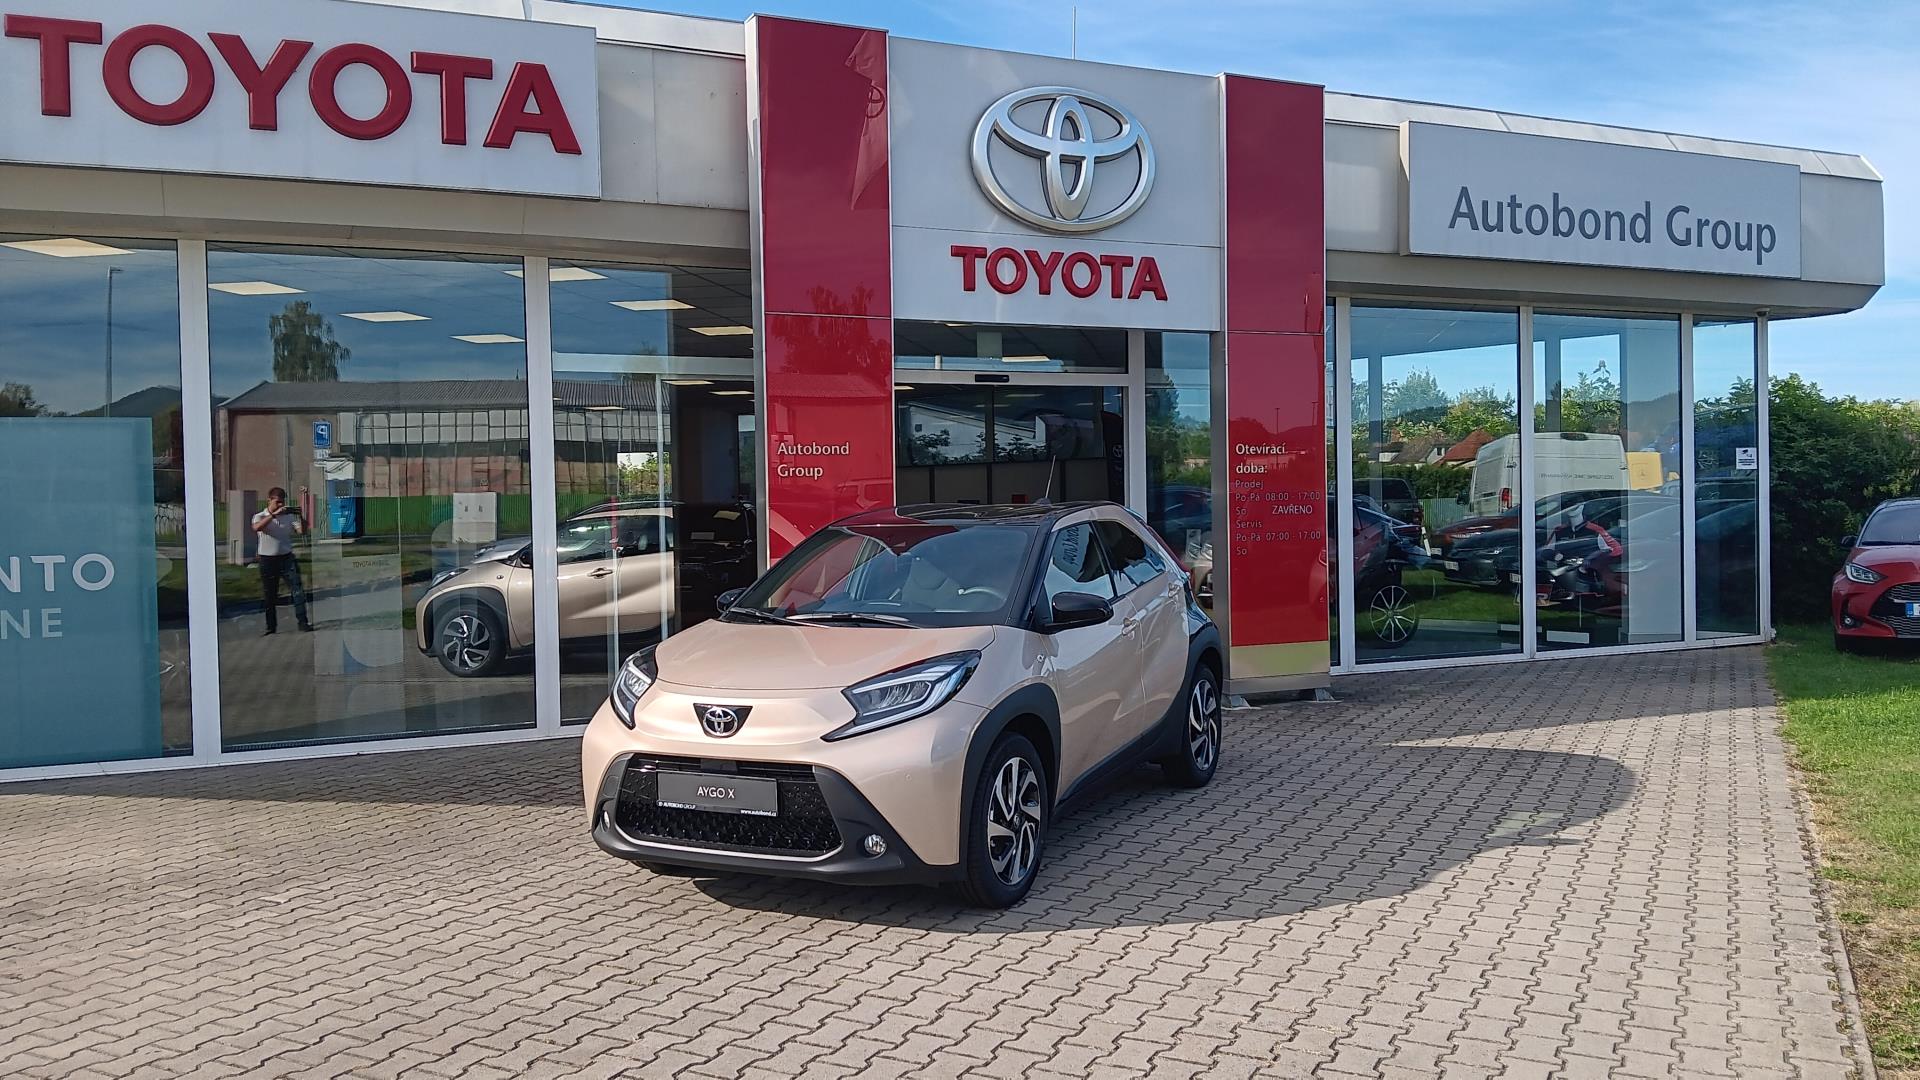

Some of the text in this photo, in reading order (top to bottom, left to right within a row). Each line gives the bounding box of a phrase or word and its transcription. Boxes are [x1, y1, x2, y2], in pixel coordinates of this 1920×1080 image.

[4, 14, 582, 155] TOYOTA
[1448, 186, 1777, 266] Autobond Group
[951, 245, 1168, 301] TOYOTA
[777, 441, 850, 455] Autobond
[1235, 442, 1286, 455] Otevírací
[777, 464, 823, 480] Group
[1235, 462, 1268, 474] doba:
[1235, 480, 1264, 490] Prodej
[1265, 492, 1289, 501] 08:00
[1298, 491, 1320, 500] 17:00
[1235, 503, 1313, 515] So ZAVŘENO
[1236, 520, 1263, 529] Servis
[1265, 532, 1289, 541] 07:00
[1299, 530, 1321, 540] 17:00
[1236, 546, 1248, 555] So
[696, 786, 735, 799] AYGO X
